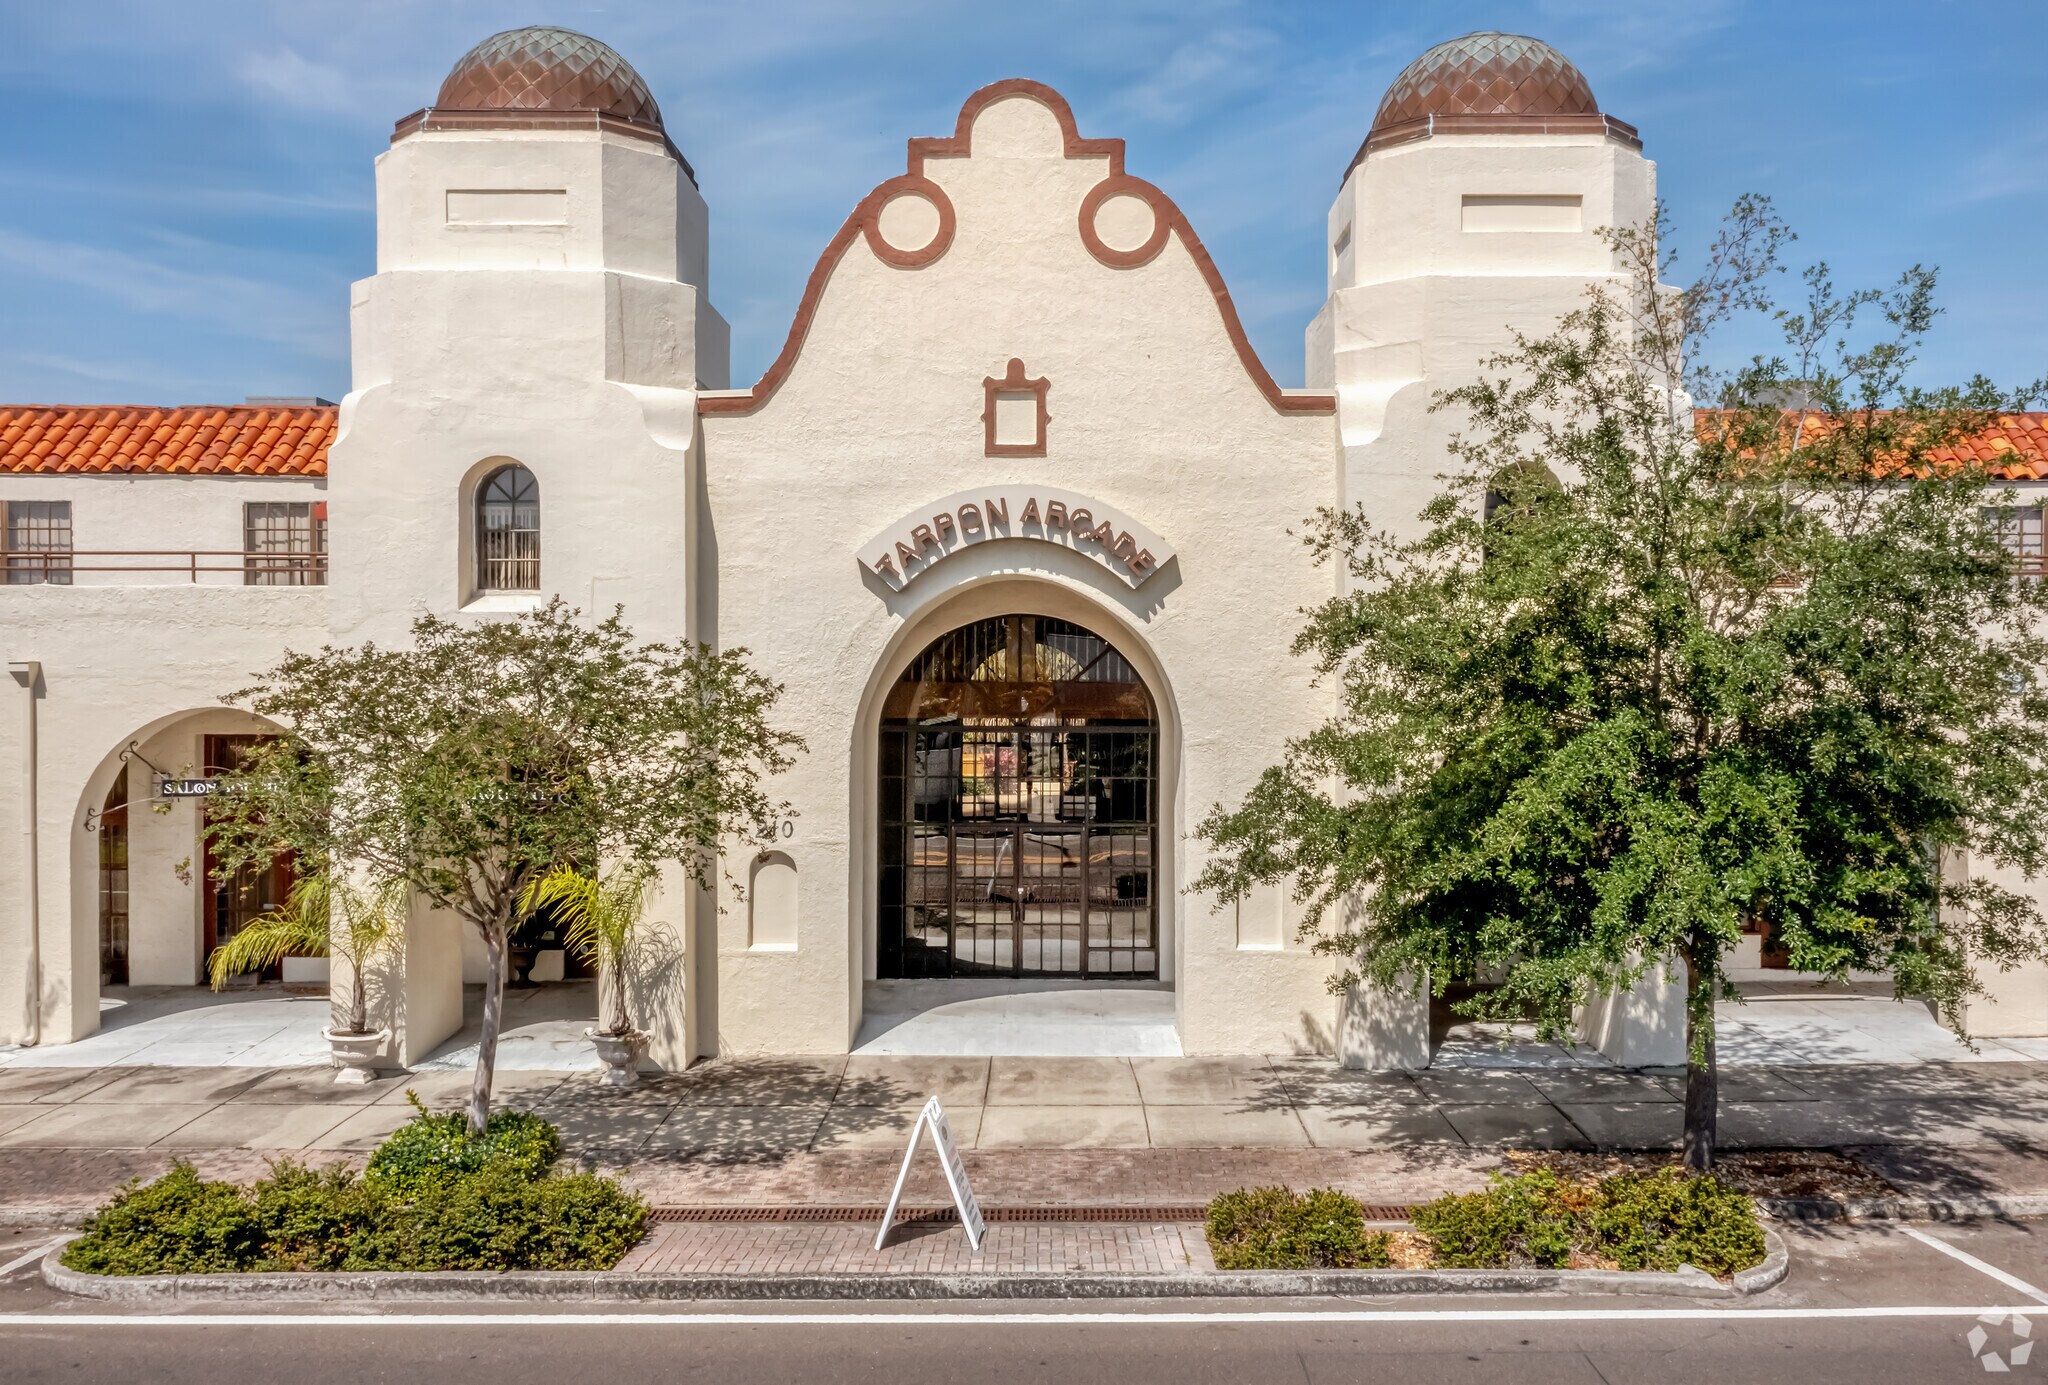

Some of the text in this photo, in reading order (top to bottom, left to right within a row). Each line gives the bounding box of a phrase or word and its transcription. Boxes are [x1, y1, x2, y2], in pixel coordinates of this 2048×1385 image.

[874, 498, 1156, 579] TARPON ARCADE
[163, 782, 217, 794] SALON
